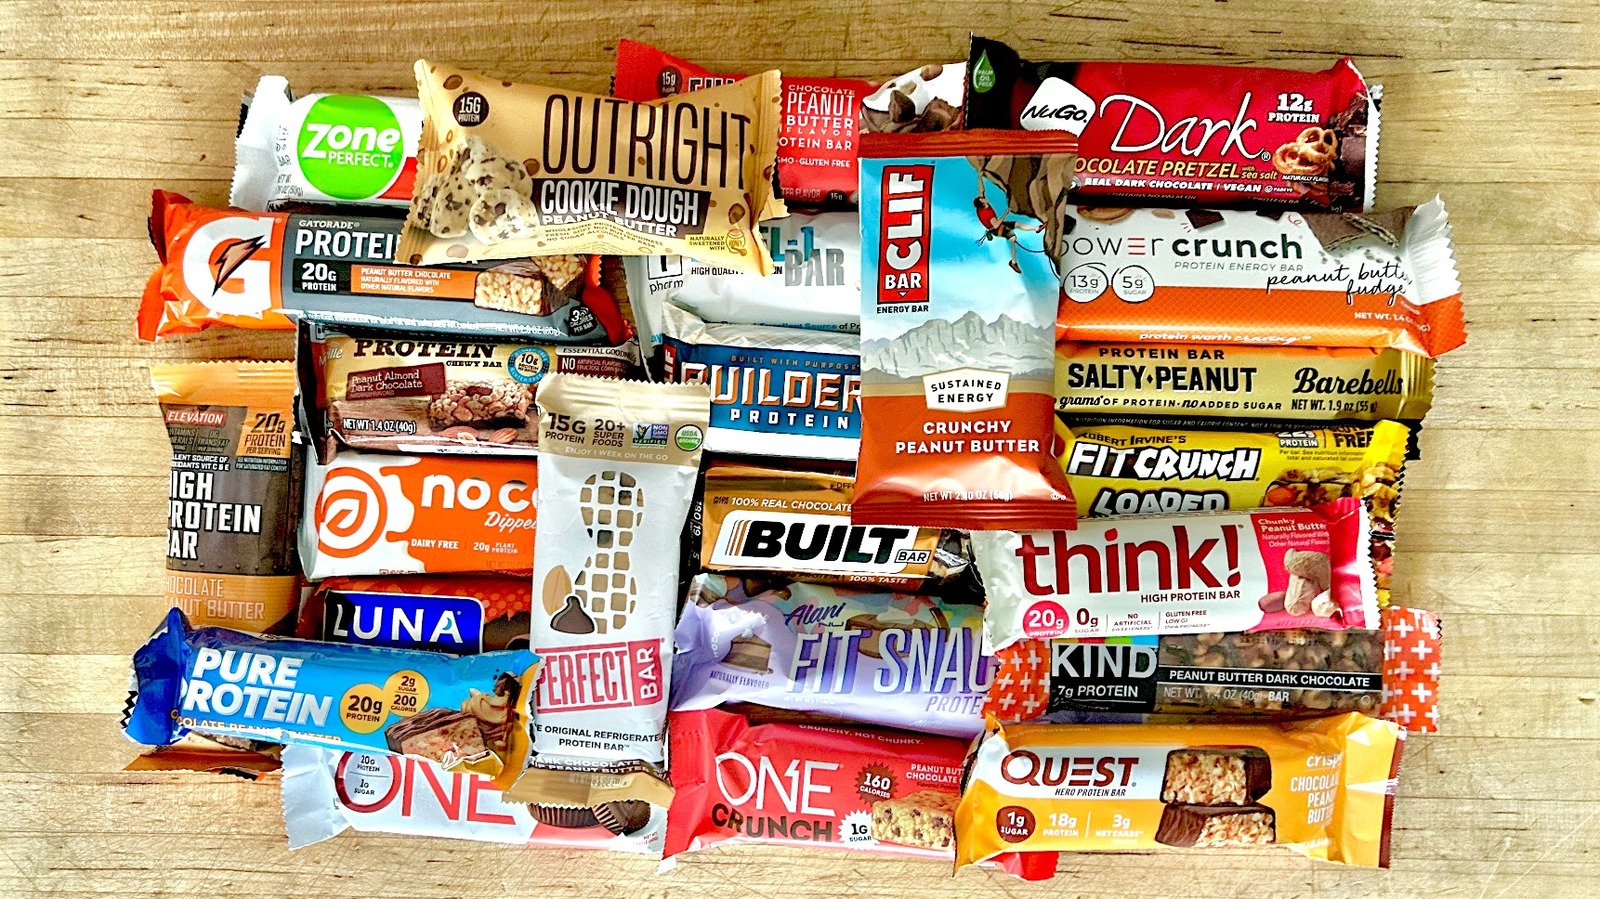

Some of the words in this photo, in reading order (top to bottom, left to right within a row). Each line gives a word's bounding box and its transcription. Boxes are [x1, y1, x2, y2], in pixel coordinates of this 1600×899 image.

[788, 84, 855, 96] CHOCOLATE
[459, 96, 481, 114] 15G
[787, 92, 855, 117] PEANUT
[1277, 93, 1313, 112] 12g
[786, 115, 853, 129] BUTTER
[1268, 112, 1320, 123] PROTEIN
[1100, 92, 1264, 159] Dark
[542, 94, 750, 189] OUTRIGHT
[827, 141, 852, 151] BAR
[1160, 159, 1239, 178] PRETZEL
[1241, 171, 1258, 180] sea
[1260, 171, 1278, 180] salt
[1085, 178, 1111, 187] REAL
[1115, 179, 1146, 188] DARK
[1149, 179, 1213, 190] CHOCOLATE
[1223, 183, 1262, 192] VEGAN
[541, 179, 620, 215] COOKIE
[626, 184, 699, 226] DOUGH
[299, 219, 354, 230] GATORADE
[542, 211, 607, 225] PEANUT
[614, 217, 677, 237] BUTTER
[886, 172, 924, 270] CLIF
[1172, 233, 1303, 259] crunch
[183, 217, 276, 318] G
[361, 268, 386, 276] PEANUT
[388, 269, 413, 278] BUTTER
[415, 270, 451, 279] CHOCOLATE
[785, 248, 845, 287] BAR
[1174, 261, 1225, 270] PROTEIN
[1229, 262, 1276, 272] ENERGY
[1280, 263, 1303, 271] BAR
[885, 273, 922, 289] BAR
[1122, 275, 1144, 289] 5g
[1266, 264, 1350, 294] peanut
[302, 282, 337, 292] PROTEIN
[1346, 279, 1407, 306] fudge
[877, 305, 910, 314] ENERGY
[911, 304, 929, 313] BAR
[354, 338, 498, 358] PROTEIN
[1099, 347, 1179, 359] PROTEIN
[1188, 349, 1225, 359] BAR
[562, 357, 576, 370] NO
[771, 357, 798, 366] WITH
[384, 369, 420, 380] Almond
[1068, 363, 1146, 390] SALTY
[1155, 366, 1257, 393] PEANUT
[1292, 367, 1403, 395] Barebells
[376, 379, 423, 390] Chocolate
[931, 379, 1002, 392] SUSTAINED
[938, 392, 994, 404] ENERGY
[1103, 398, 1118, 406] OF
[1123, 399, 1178, 407] PROTEIN
[1182, 400, 1198, 408] no
[1200, 401, 1239, 409] ADDED
[1244, 402, 1282, 410] SUGAR
[1291, 399, 1308, 410] NET
[1311, 400, 1326, 411] WT.
[1329, 400, 1341, 411] 1.9
[168, 412, 224, 424] ELEVATION
[251, 413, 286, 433] 20g
[547, 412, 586, 434] 15G
[730, 408, 849, 430] PROTEIN
[343, 418, 356, 430] NET
[356, 419, 369, 430] WT
[371, 420, 383, 431] 1.4
[384, 420, 395, 432] OZ
[396, 421, 417, 434] (40g)
[594, 419, 626, 432] 20+
[923, 420, 1012, 434] CRUNCHY
[244, 434, 286, 447] PROTEIN
[545, 432, 585, 445] PROTEIN
[594, 431, 625, 440] SUPER
[1279, 438, 1319, 447] PROTEIN
[592, 439, 624, 448] FOODS
[896, 441, 965, 454] PEANUT
[970, 440, 1040, 452] BUTTER
[600, 450, 622, 458] WEEK
[639, 453, 654, 461] THE
[1067, 441, 1136, 477] FIT
[1133, 446, 1262, 480] CRUNCH
[923, 493, 939, 502] NET
[940, 492, 953, 501] WT
[1092, 490, 1227, 514] LOADED
[732, 497, 759, 507] 100%
[761, 498, 788, 508] REAL
[791, 501, 852, 512] CHOCOLATE
[1258, 517, 1295, 526] Chunky
[1261, 523, 1297, 533] Peanut
[411, 538, 436, 549] DAIRY
[438, 540, 458, 550] FREE
[473, 542, 490, 553] 20g
[742, 520, 909, 564] BUILT
[898, 551, 927, 562] BAR
[1015, 525, 1241, 596] think!
[850, 575, 875, 584] 100%
[878, 576, 908, 584] TASTE
[1140, 593, 1168, 603] HIGH
[1170, 592, 1216, 602] PROTEIN
[1219, 591, 1240, 599] BAR
[207, 600, 265, 620] BUTTER
[783, 602, 846, 626] Alani
[333, 604, 463, 643] LUNA
[1028, 609, 1064, 629] 20g
[1076, 608, 1098, 627] 0g
[786, 629, 865, 693] FIT
[1052, 643, 1158, 678] KIND
[192, 647, 305, 689] PURE
[636, 647, 658, 699] BAR
[400, 676, 416, 687] 2g
[1169, 670, 1214, 682] PEANUT
[1218, 671, 1264, 684] BUTTER
[1266, 673, 1298, 685] DARK
[1300, 674, 1370, 687] CHOCOLATE
[1058, 685, 1073, 697] 7g
[1077, 685, 1139, 697] PROTEIN
[1163, 687, 1182, 697] NET
[1267, 691, 1289, 701] BAR
[348, 695, 382, 714] 20g
[393, 694, 417, 706] 200
[346, 712, 380, 723] PROTEIN
[545, 725, 591, 737] ORIGINAL
[559, 738, 601, 749] PROTEIN
[604, 742, 624, 751] BAR
[549, 763, 598, 772] PEANUT
[562, 758, 640, 768] CHOCOLATE
[911, 763, 944, 773] PEANUT
[1001, 750, 1139, 787] QUEST
[715, 751, 839, 816] ONE
[863, 772, 890, 790] 160
[906, 771, 957, 783] CHOCOLATE
[859, 785, 891, 799] CALORIES
[1055, 788, 1075, 796] HERO
[712, 803, 833, 842] CRUNCH
[1007, 812, 1025, 827] 1g
[1049, 813, 1077, 827] 18g
[1113, 814, 1131, 829] 3g
[1001, 826, 1028, 836] SUGAR
[1043, 829, 1079, 837] PROTEIN
